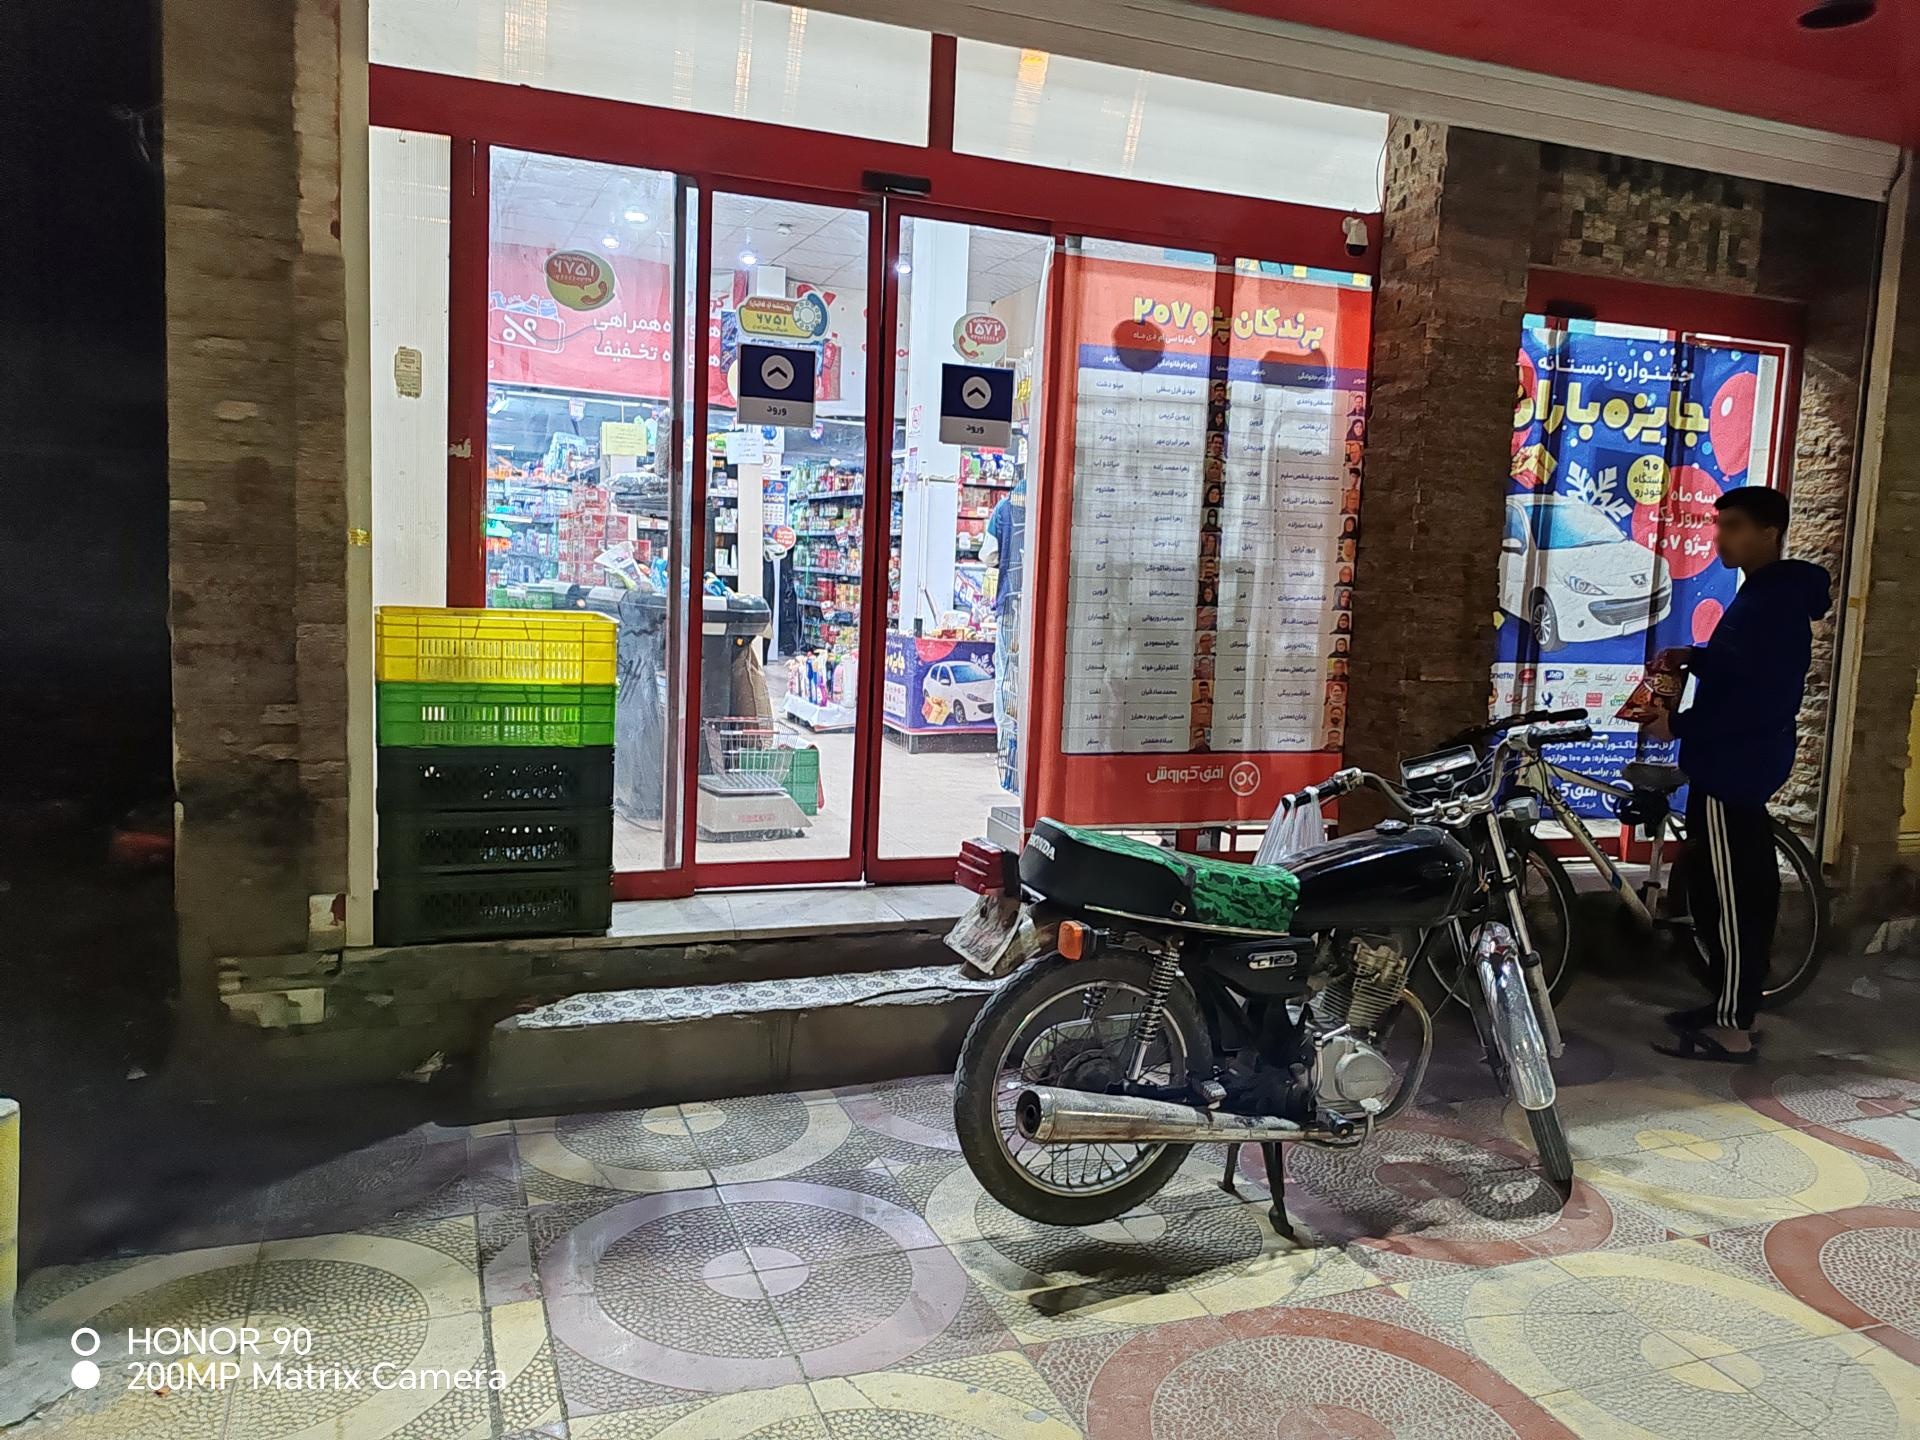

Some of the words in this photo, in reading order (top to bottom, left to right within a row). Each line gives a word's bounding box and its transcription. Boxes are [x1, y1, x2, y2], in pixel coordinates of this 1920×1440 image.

[1134, 297, 1192, 328] ۲۰۷
[969, 322, 1001, 336] ۱۵۷۲
[1234, 307, 1324, 349] برندگان
[594, 340, 658, 362] تخفیف
[1537, 355, 1614, 382] زمستانه
[1617, 361, 1695, 385] جشنواره
[767, 406, 787, 416] ورود
[1602, 390, 1710, 449] جایزه
[966, 424, 984, 435] ورود
[1643, 459, 1659, 471] ۹۰
[1632, 472, 1665, 485] دستگاه
[1633, 486, 1663, 498] خودرو
[1670, 485, 1693, 503] ماه
[1694, 490, 1717, 505] سه
[1648, 532, 1681, 550] ۲۰۷
[1684, 534, 1713, 559] پژو
[1147, 766, 1200, 784] کوروش
[1200, 765, 1224, 782] افق
